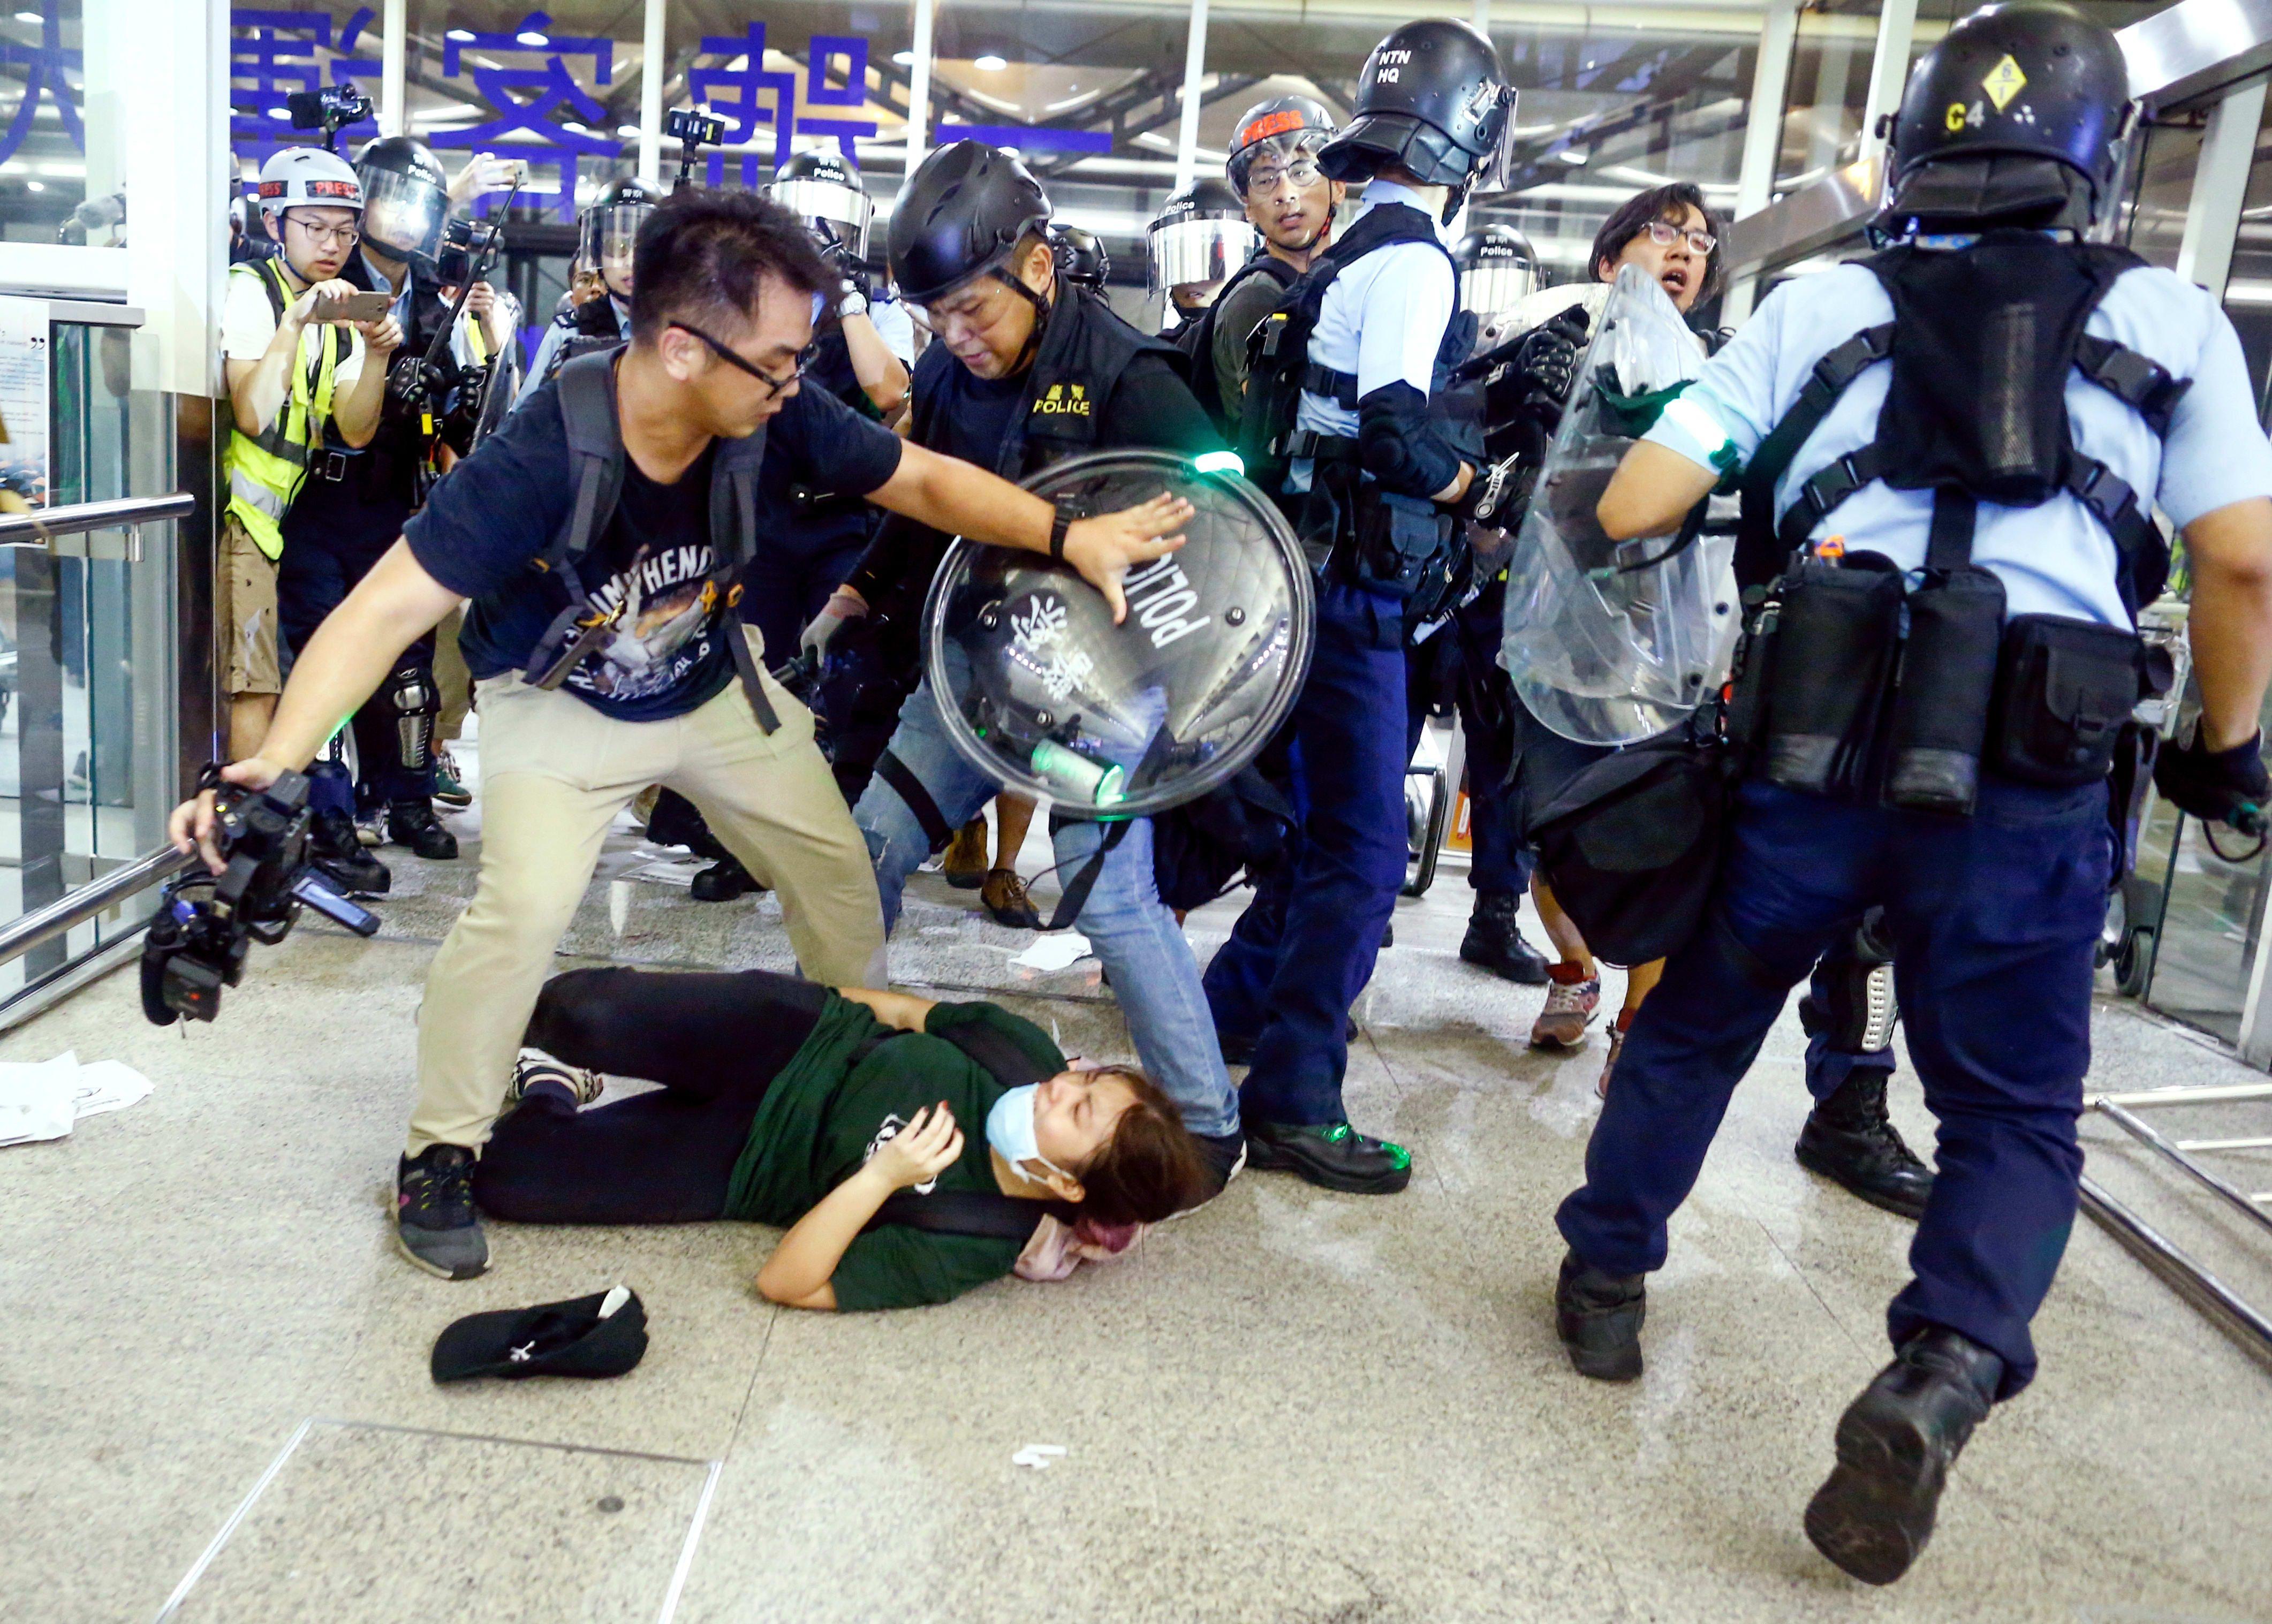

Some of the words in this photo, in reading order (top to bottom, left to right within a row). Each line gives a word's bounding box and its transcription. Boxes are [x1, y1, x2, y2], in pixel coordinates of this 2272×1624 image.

[1379, 50, 1412, 65] NTN
[1377, 67, 1399, 84] HQ
[1241, 109, 1305, 147] PRESS
[407, 164, 437, 184] Police
[813, 167, 845, 181] Police
[315, 181, 357, 199] PRESS
[1165, 200, 1195, 215] Police
[1480, 244, 1513, 257] Police
[1032, 399, 1090, 416] POLICE
[1122, 536, 1211, 649] POLIC
[1011, 594, 1094, 701] 警察
